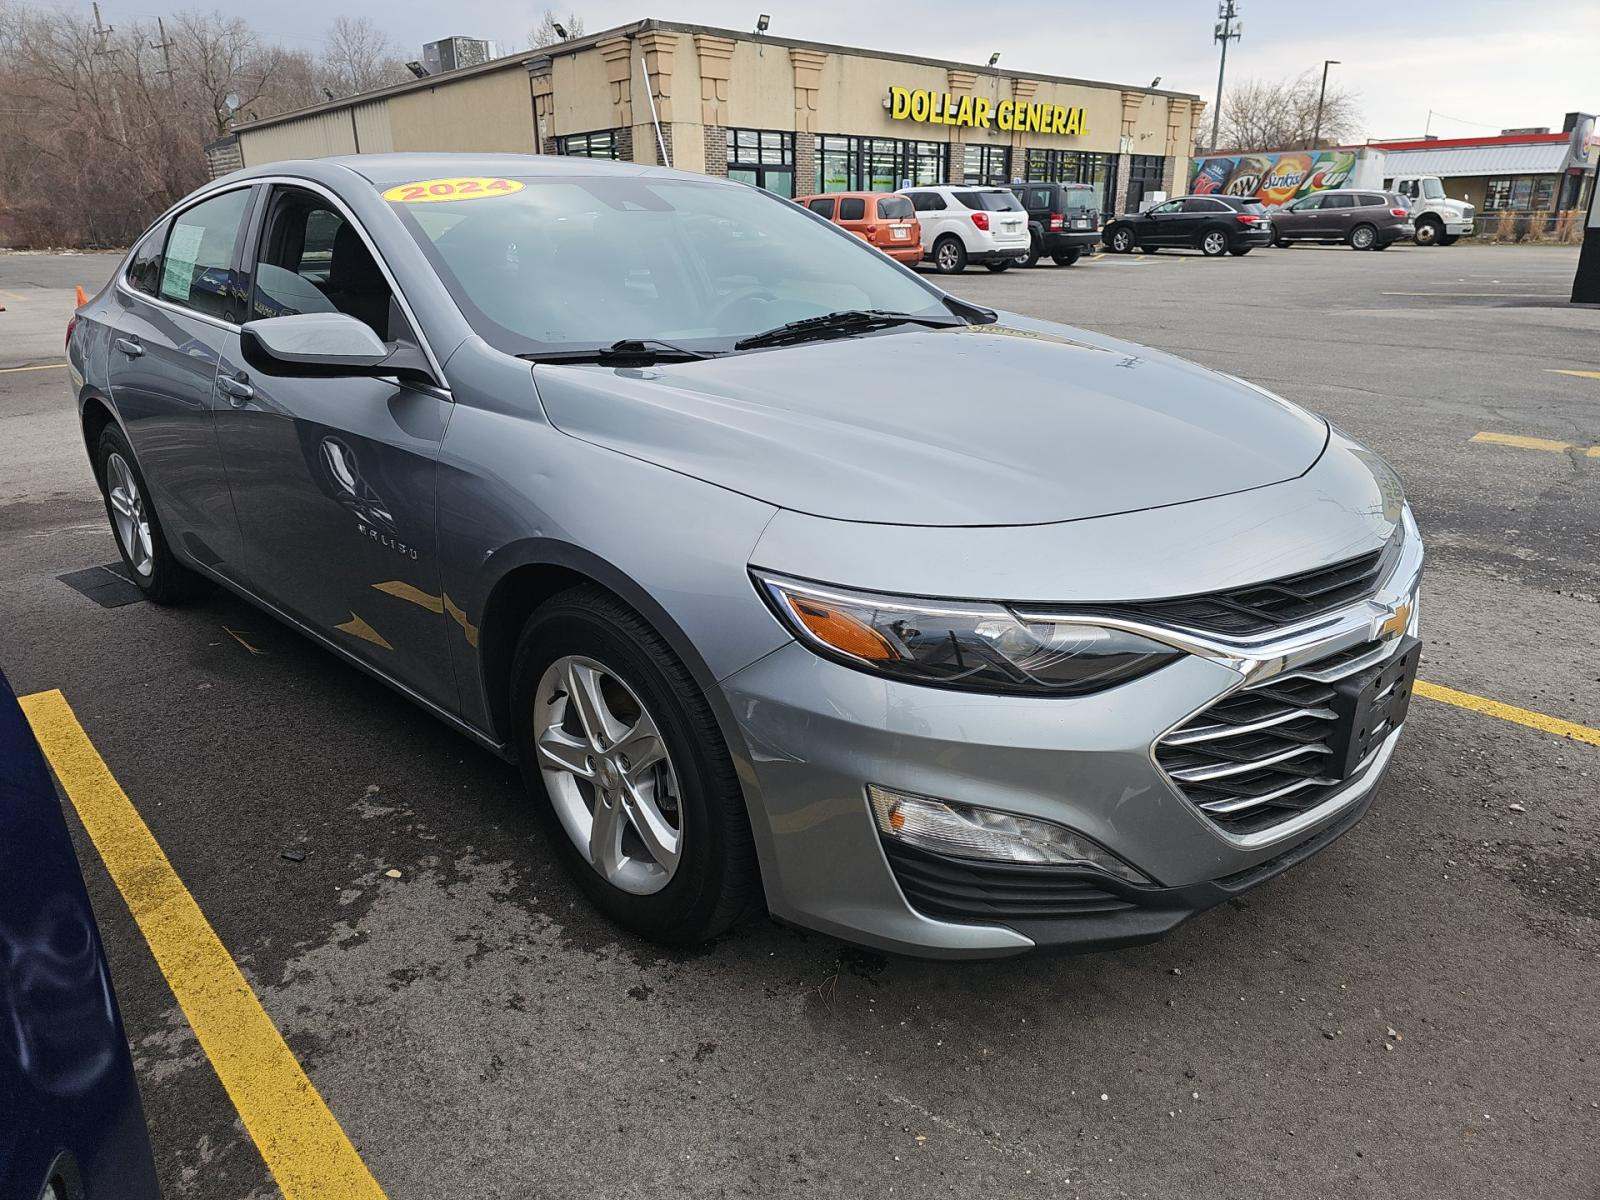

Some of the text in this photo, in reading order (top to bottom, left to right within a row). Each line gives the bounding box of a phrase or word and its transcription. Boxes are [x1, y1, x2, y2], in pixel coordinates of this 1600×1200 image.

[891, 86, 1090, 136] DOLLAR GENERAL
[401, 180, 512, 201] 2024
